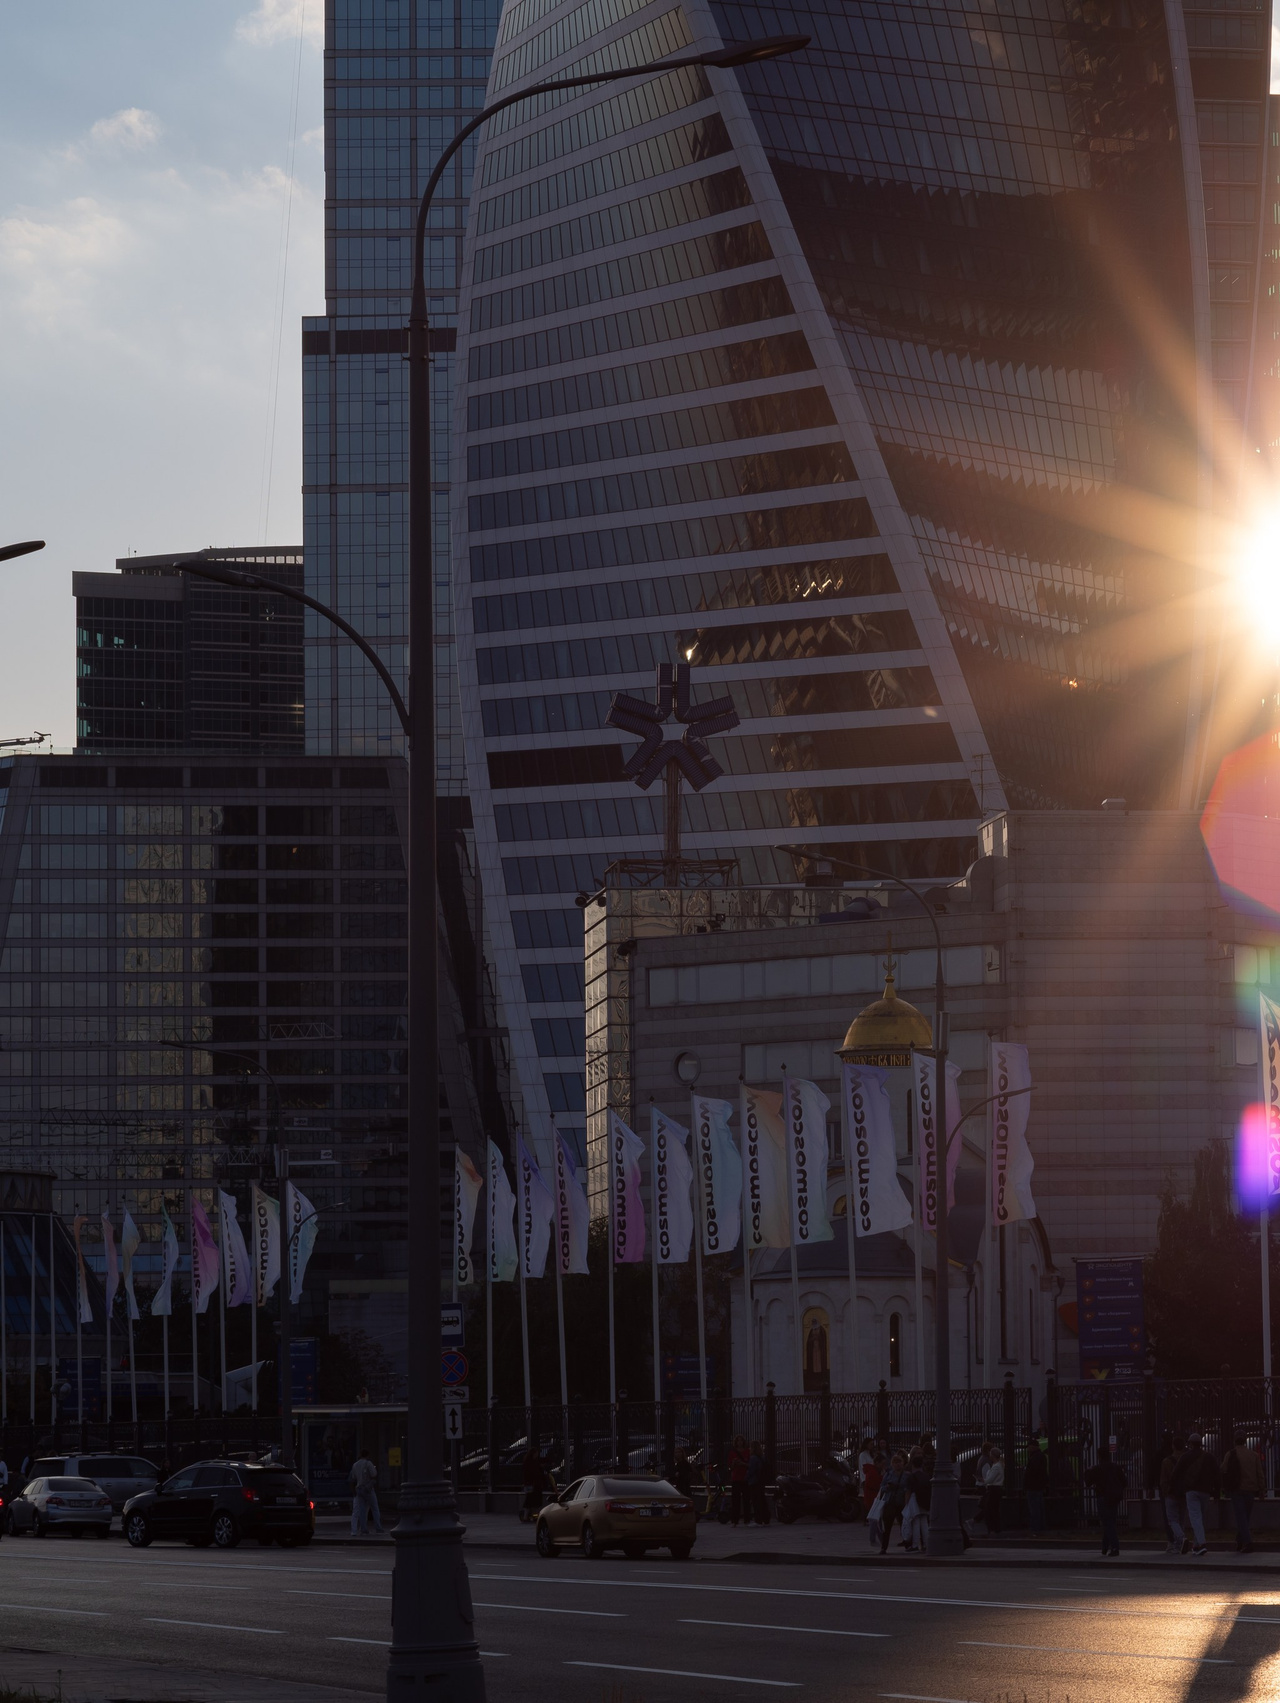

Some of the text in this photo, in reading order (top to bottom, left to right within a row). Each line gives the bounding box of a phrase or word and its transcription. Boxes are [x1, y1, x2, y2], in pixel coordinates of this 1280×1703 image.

[746, 1085, 763, 1245] cosmoscow
[850, 1067, 872, 1232] cosmoscow
[919, 1062, 937, 1226] cosmoscow
